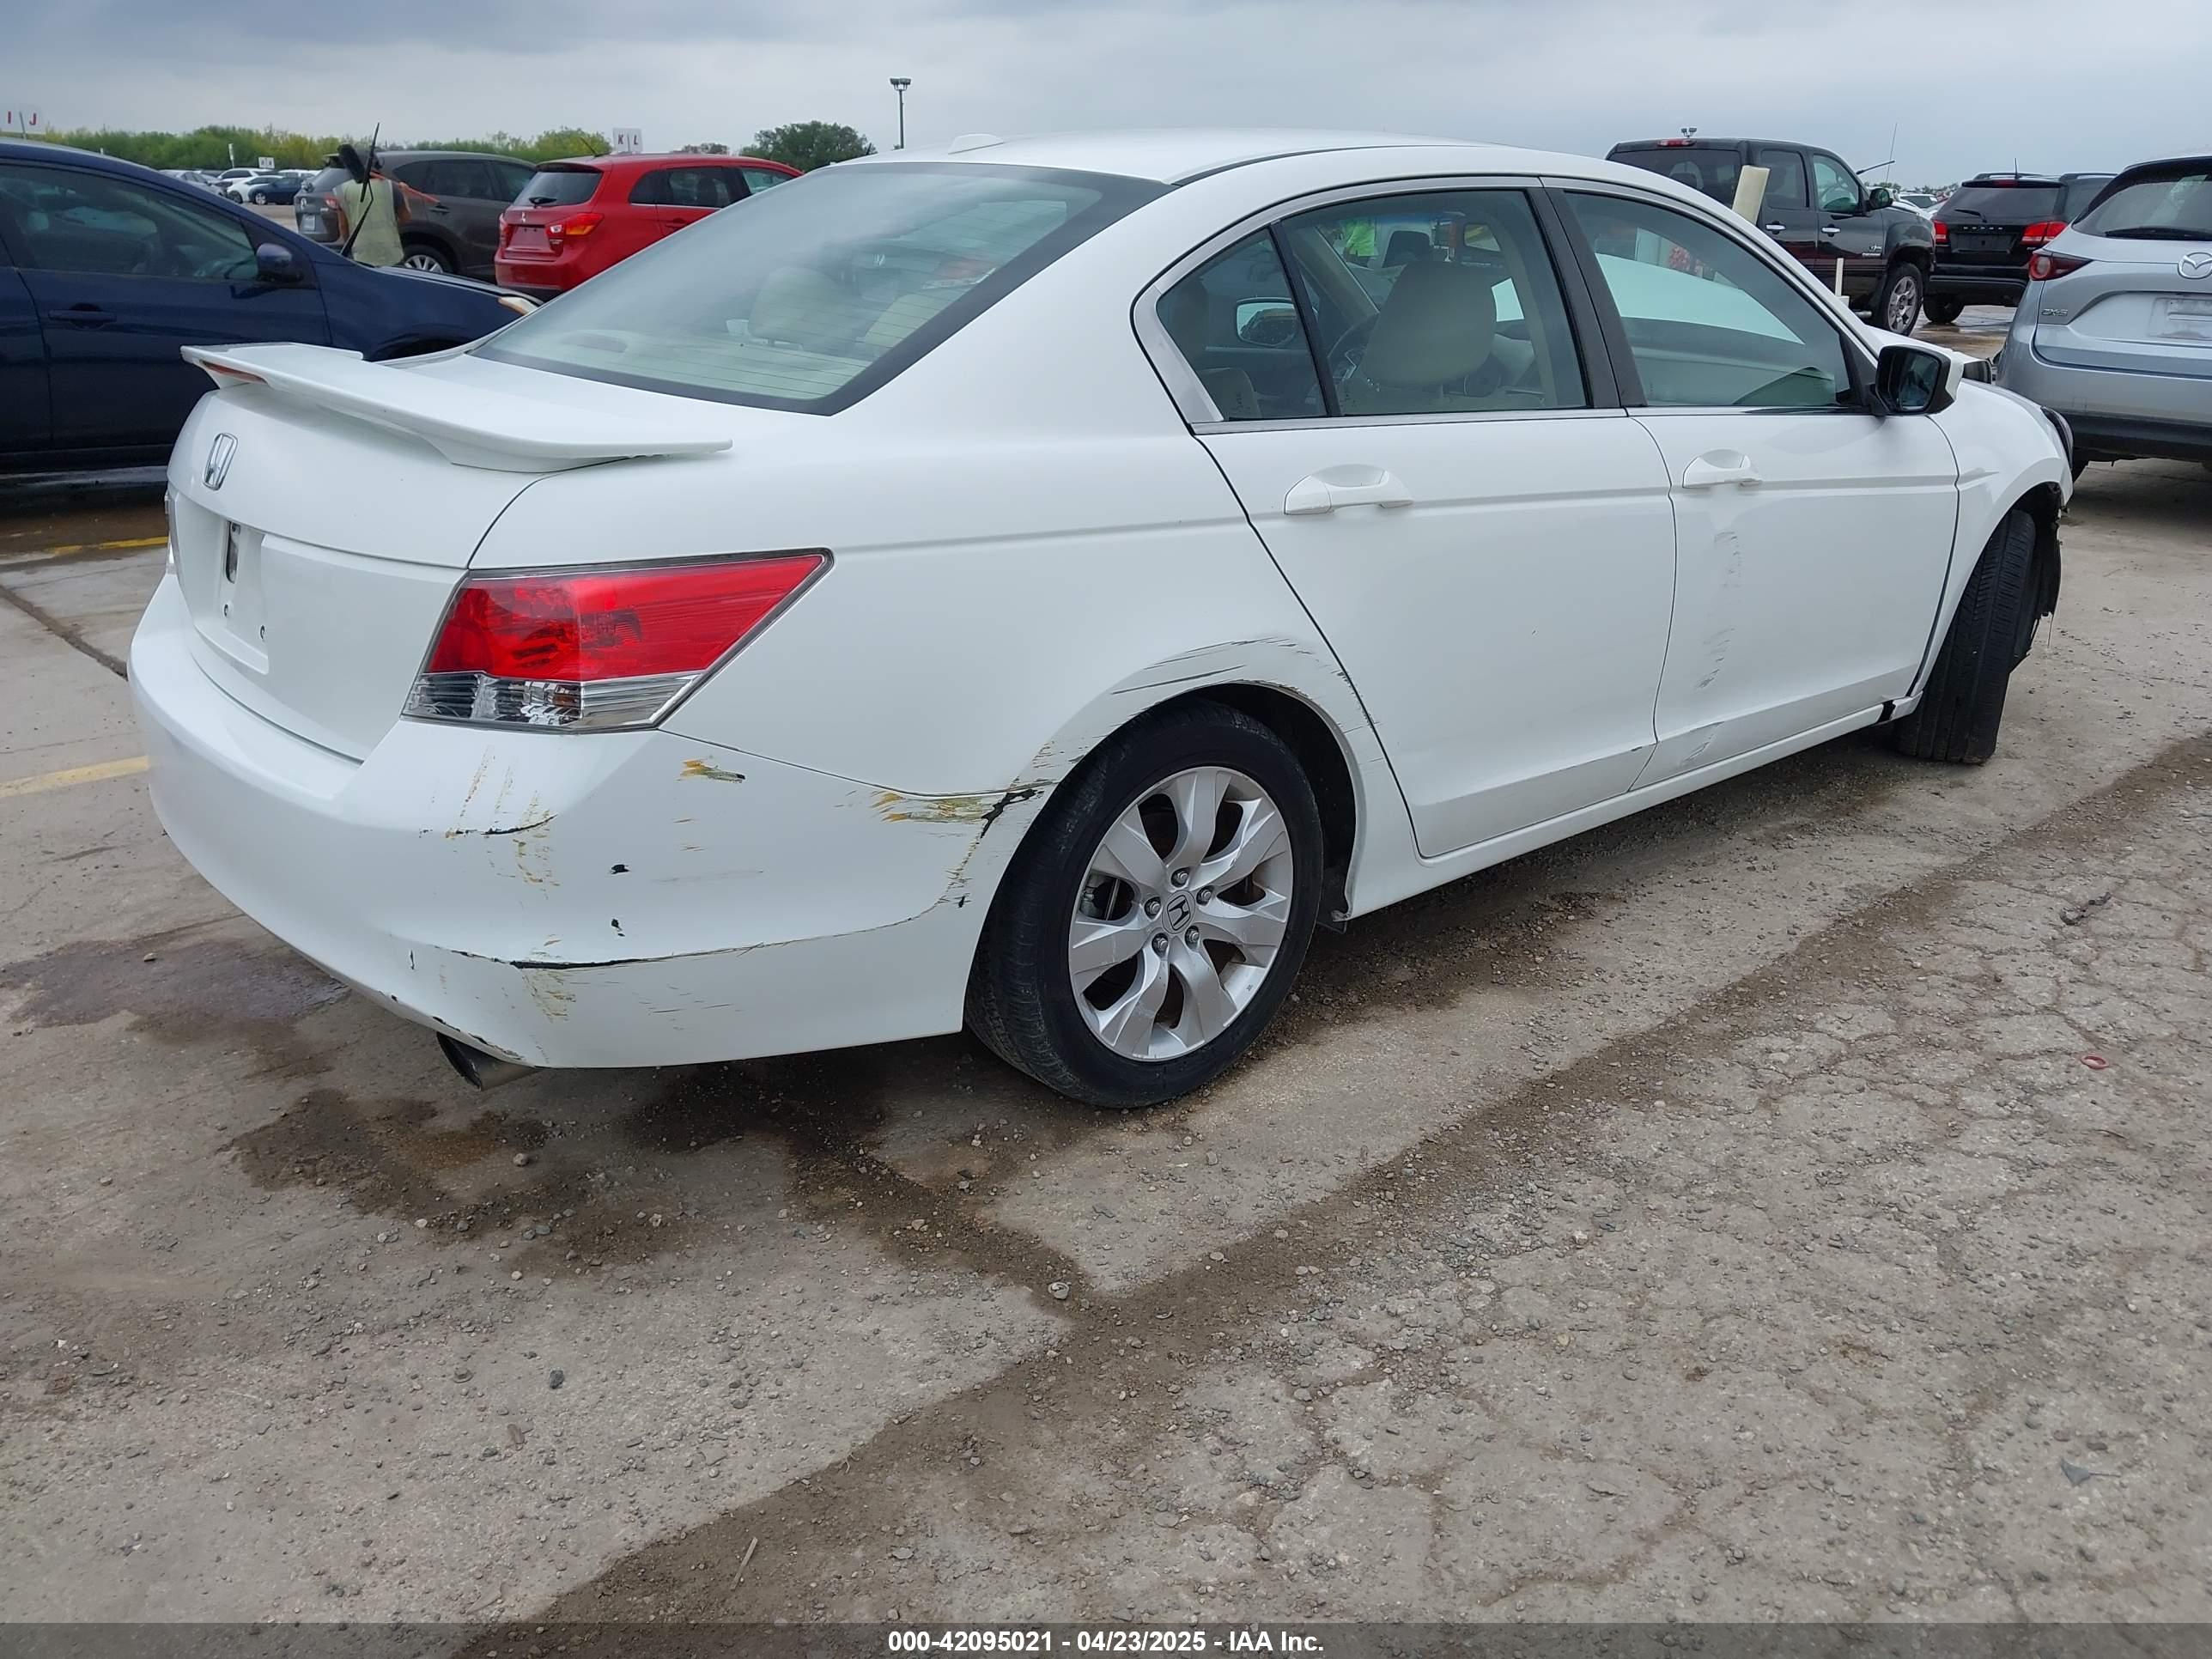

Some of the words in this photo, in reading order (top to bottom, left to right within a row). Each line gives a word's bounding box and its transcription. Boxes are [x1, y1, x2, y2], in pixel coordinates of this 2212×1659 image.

[29, 112, 37, 125] J
[617, 134, 624, 145] K
[634, 134, 639, 145] L
